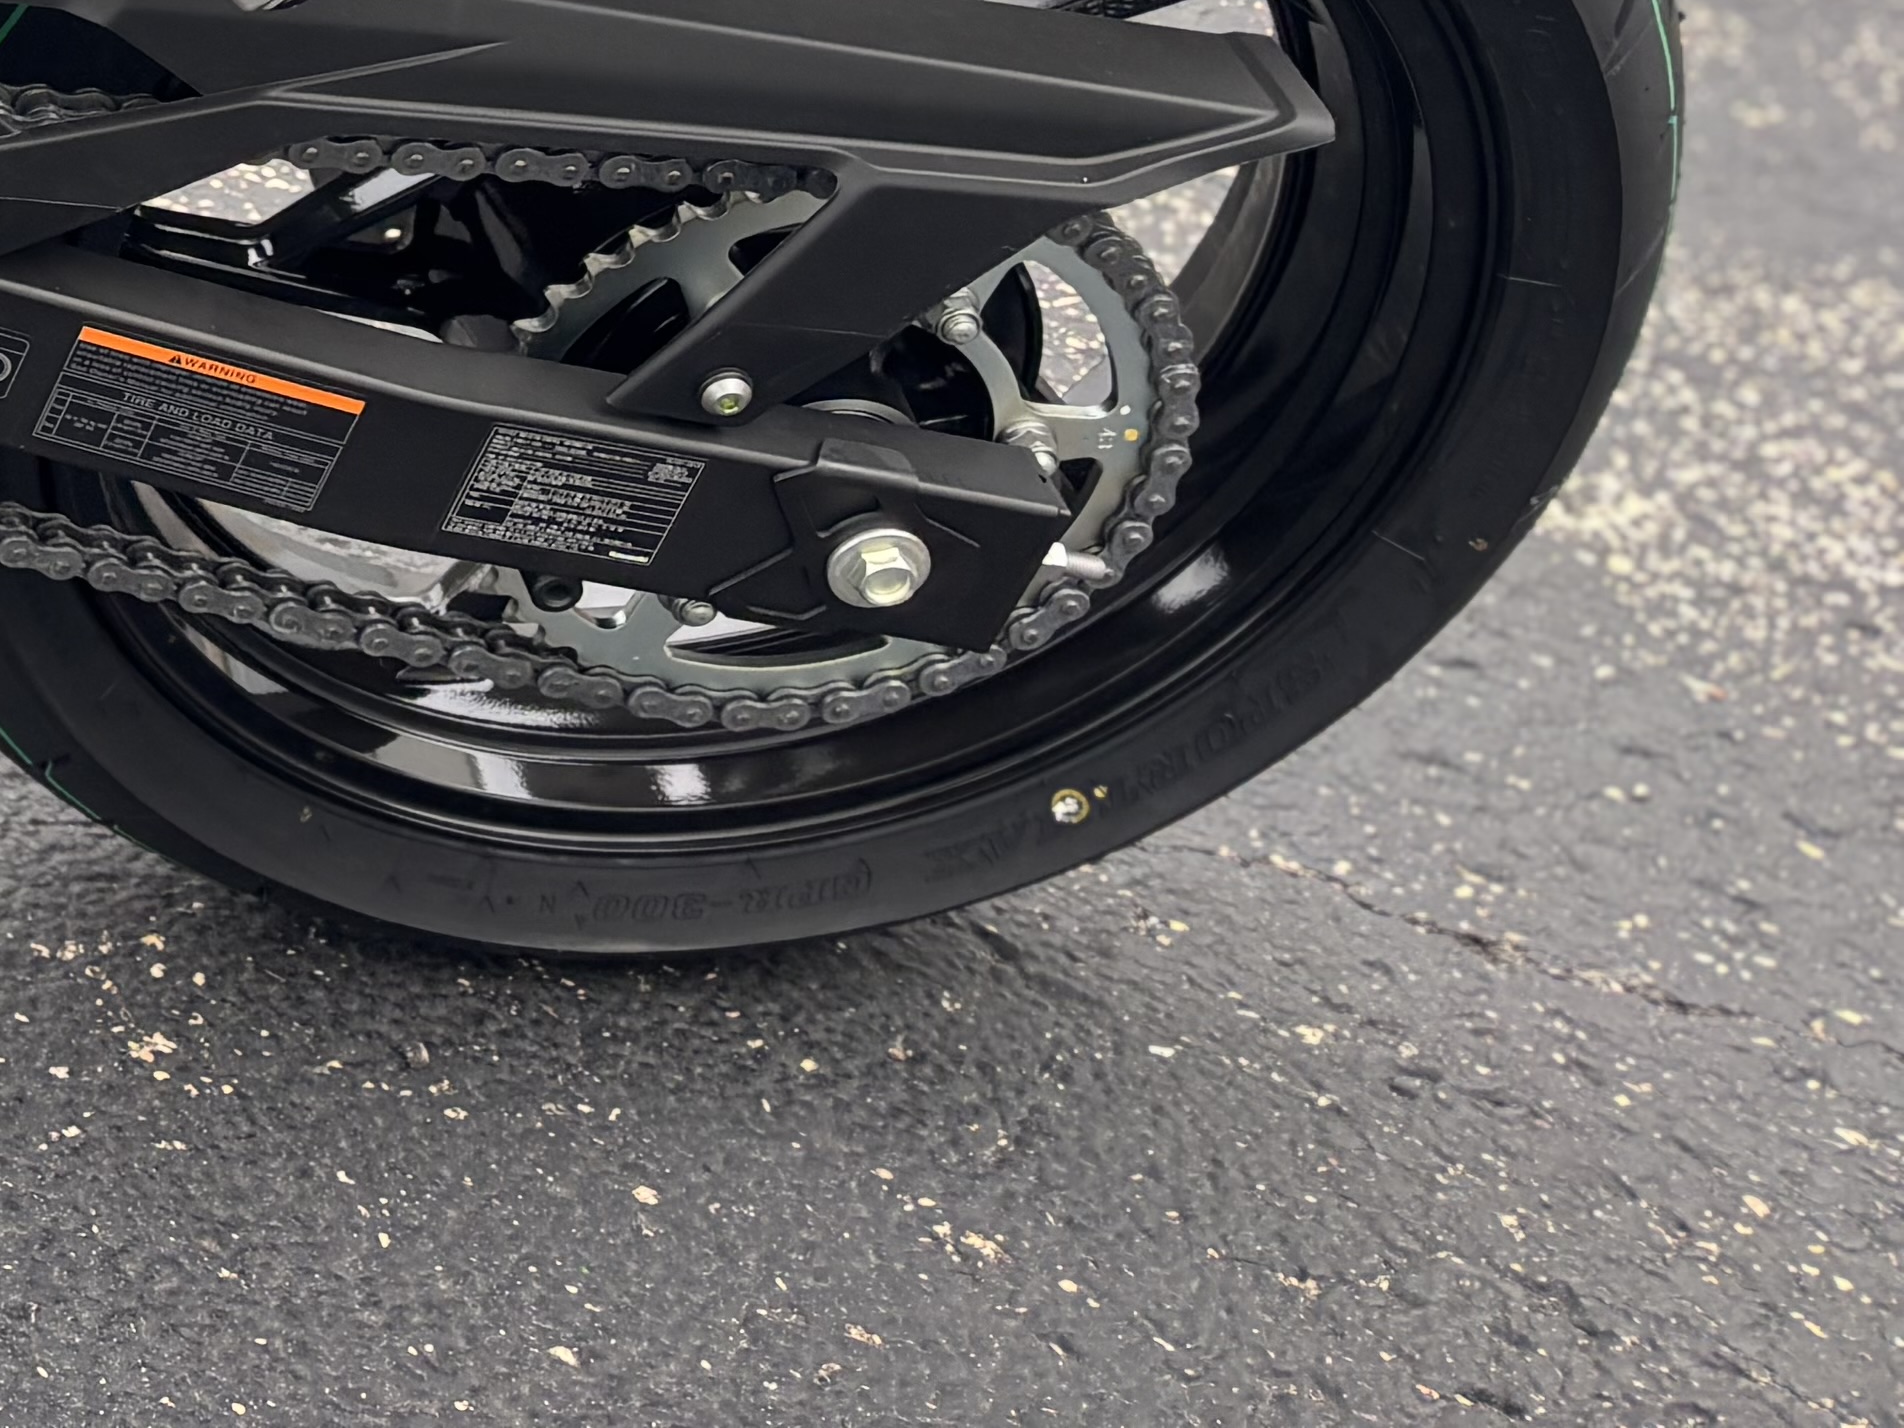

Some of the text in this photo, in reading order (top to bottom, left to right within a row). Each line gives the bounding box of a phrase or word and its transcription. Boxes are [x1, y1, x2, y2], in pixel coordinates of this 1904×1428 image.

[184, 356, 258, 385] WARNING
[122, 391, 275, 441] TIRE AND LOAD DATA
